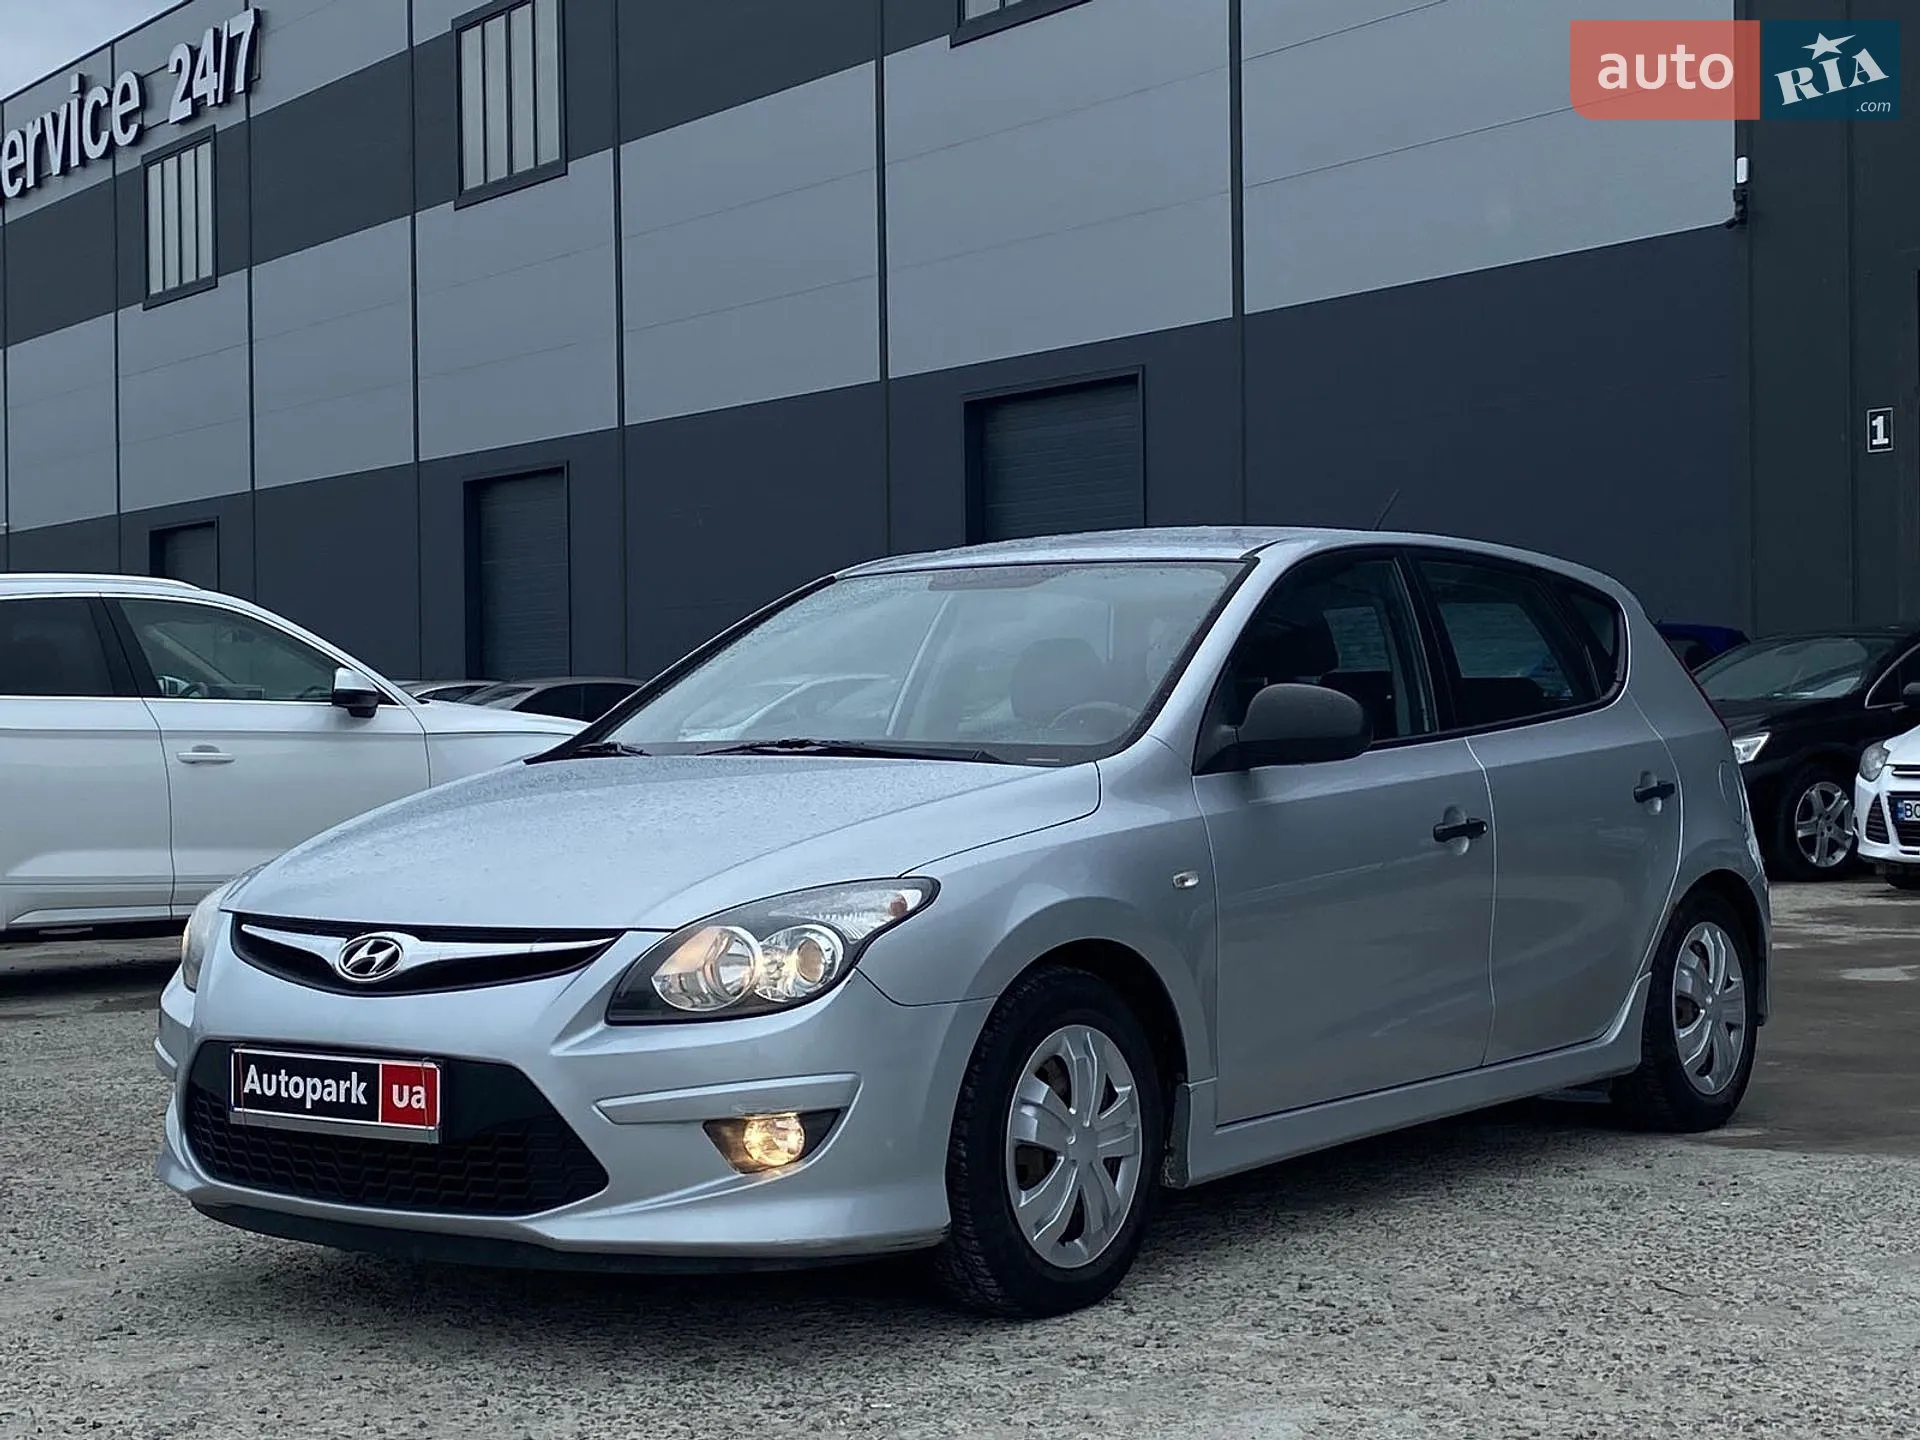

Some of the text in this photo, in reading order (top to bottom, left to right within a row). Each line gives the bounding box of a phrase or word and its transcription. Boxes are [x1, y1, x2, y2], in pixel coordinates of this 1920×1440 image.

[1, 8, 257, 198] ervice 24/7
[1872, 416, 1889, 445] 1
[243, 1064, 426, 1109] Autopark ua
